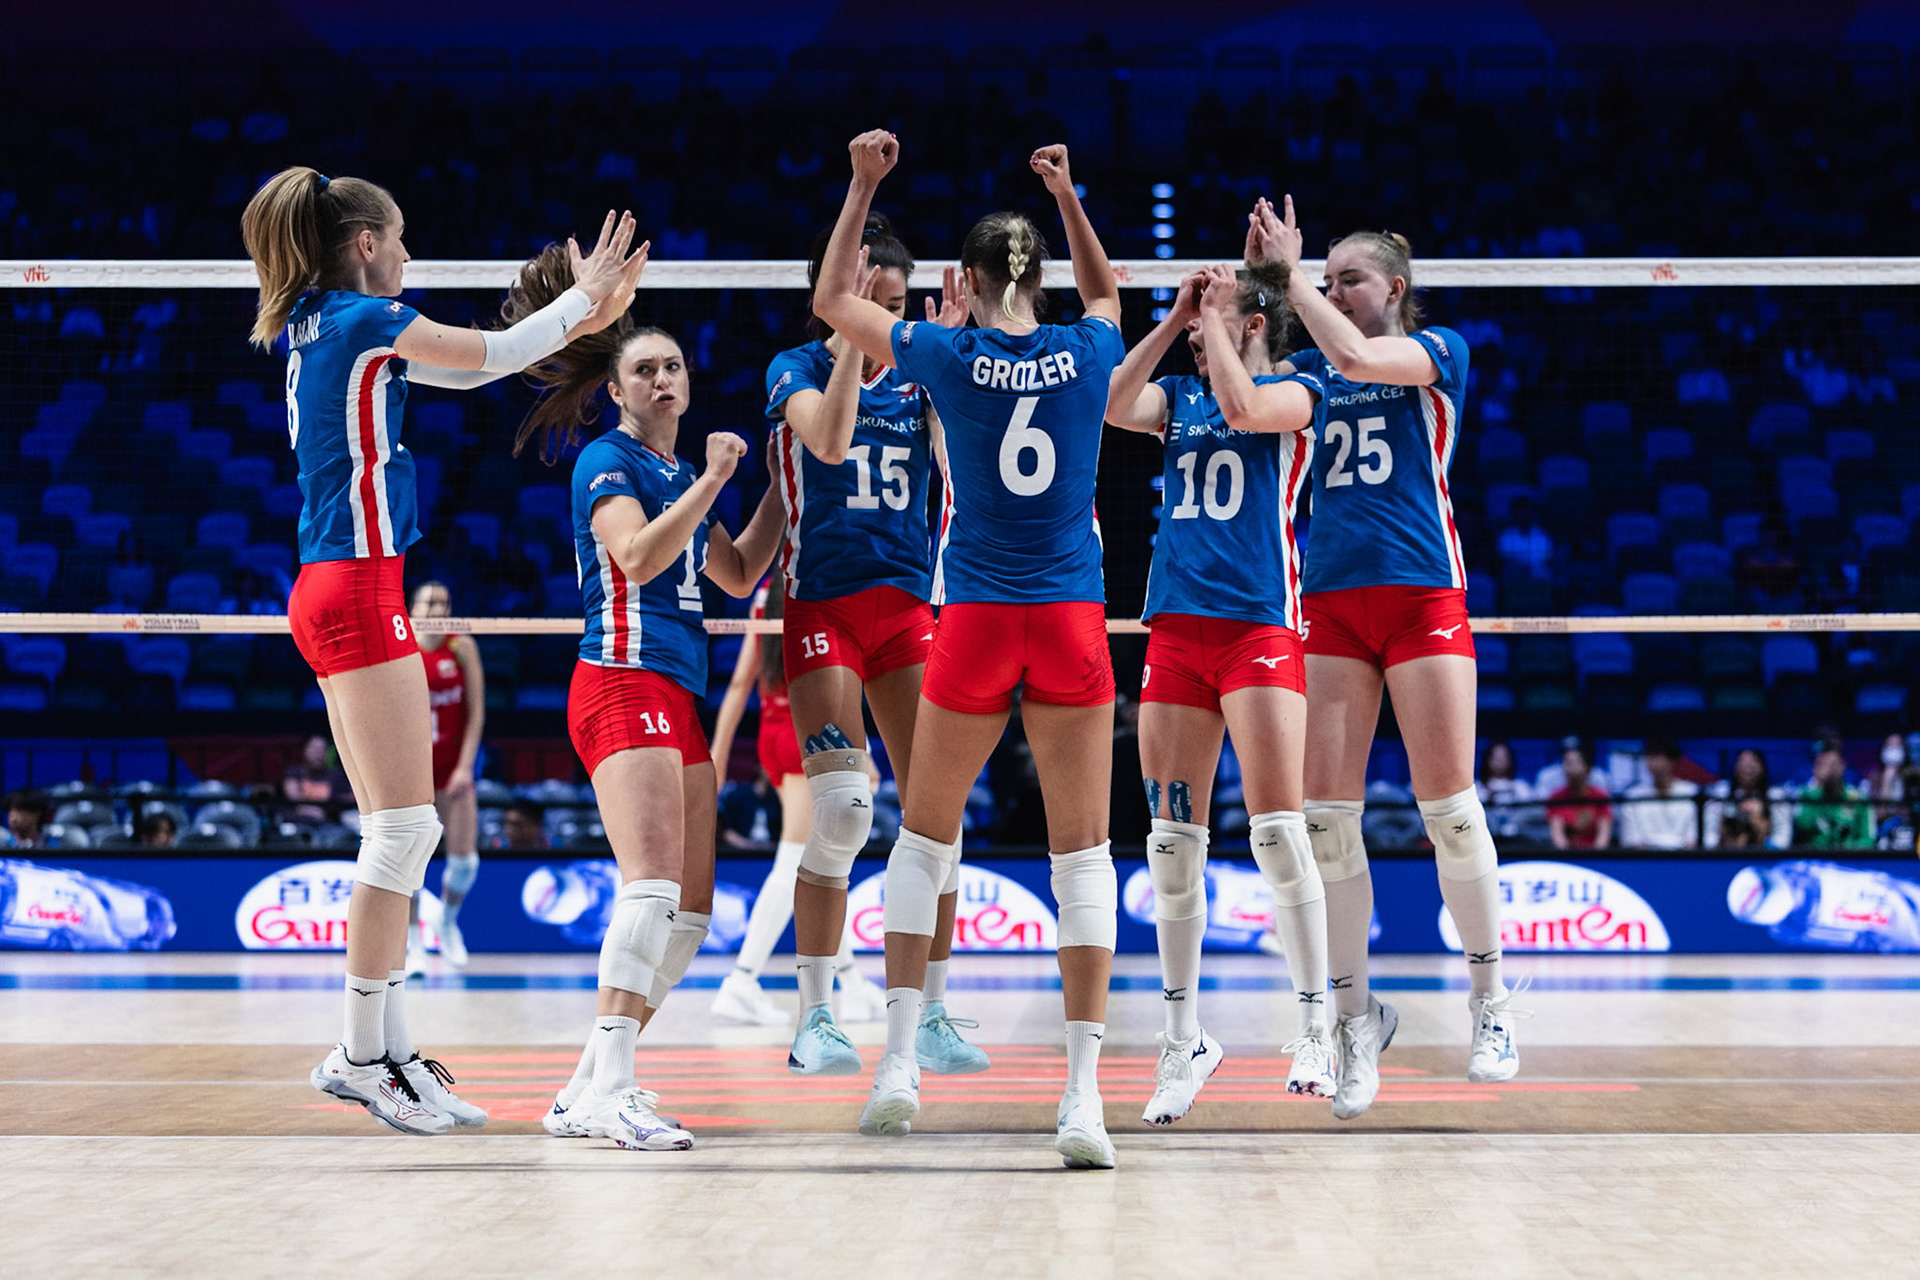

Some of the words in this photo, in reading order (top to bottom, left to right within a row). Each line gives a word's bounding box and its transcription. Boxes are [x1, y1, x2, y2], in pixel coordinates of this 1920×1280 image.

[972, 350, 1058, 391] GROZER
[286, 350, 302, 450] 8
[1329, 391, 1379, 408] SKUPINA
[999, 396, 1056, 497] 6
[1324, 416, 1393, 489] 25
[845, 445, 911, 511] 15
[1171, 449, 1245, 521] 10
[392, 614, 408, 641] 8
[801, 632, 830, 659] 15
[640, 711, 670, 735] 16
